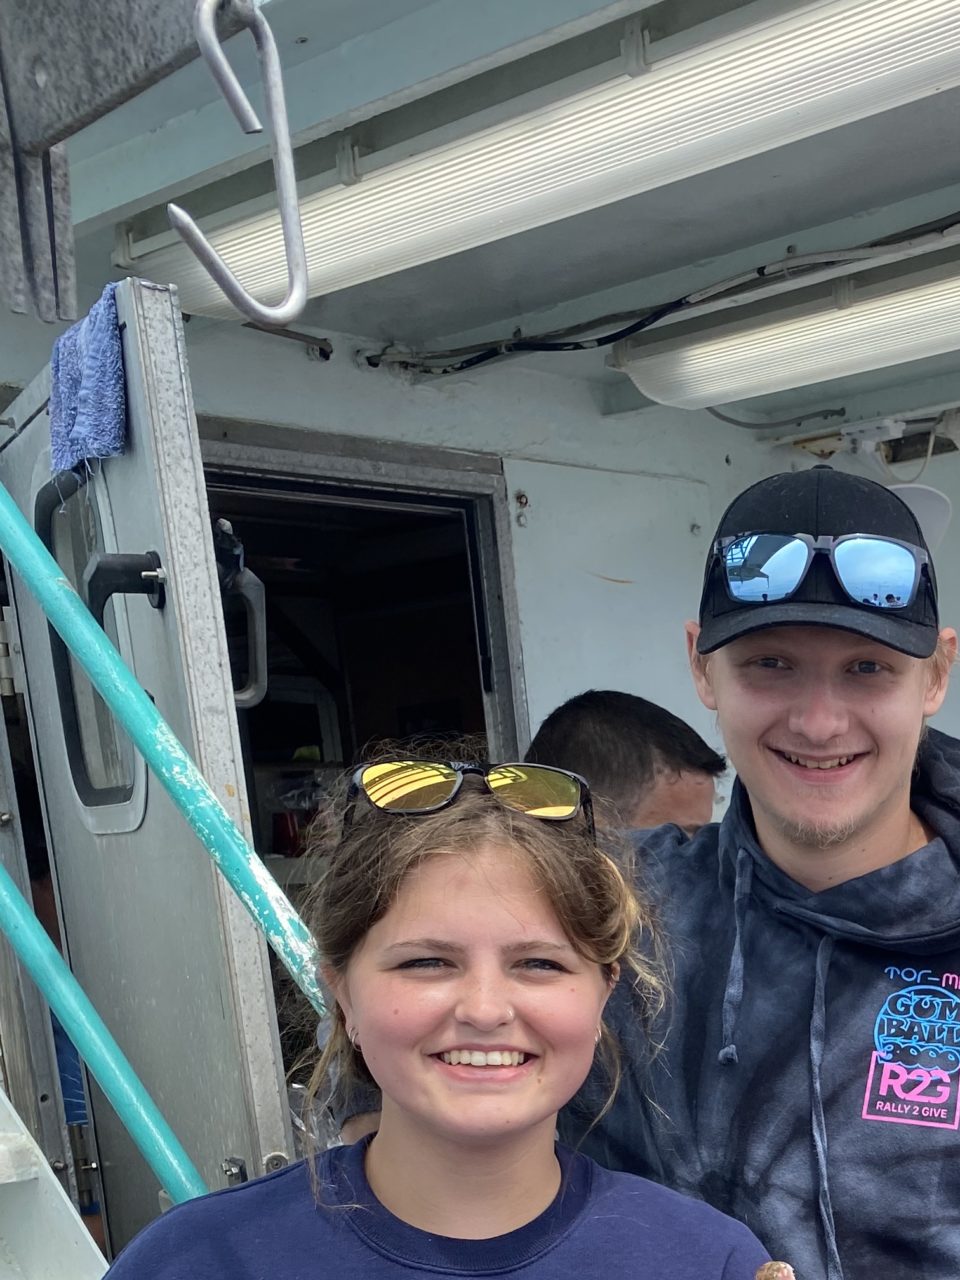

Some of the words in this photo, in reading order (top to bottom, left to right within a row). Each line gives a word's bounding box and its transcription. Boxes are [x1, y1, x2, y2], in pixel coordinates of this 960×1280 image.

[878, 1063, 951, 1104] R2G
[876, 1101, 910, 1113] RALLY
[912, 1105, 920, 1115] 2
[921, 1105, 948, 1119] GIVE
